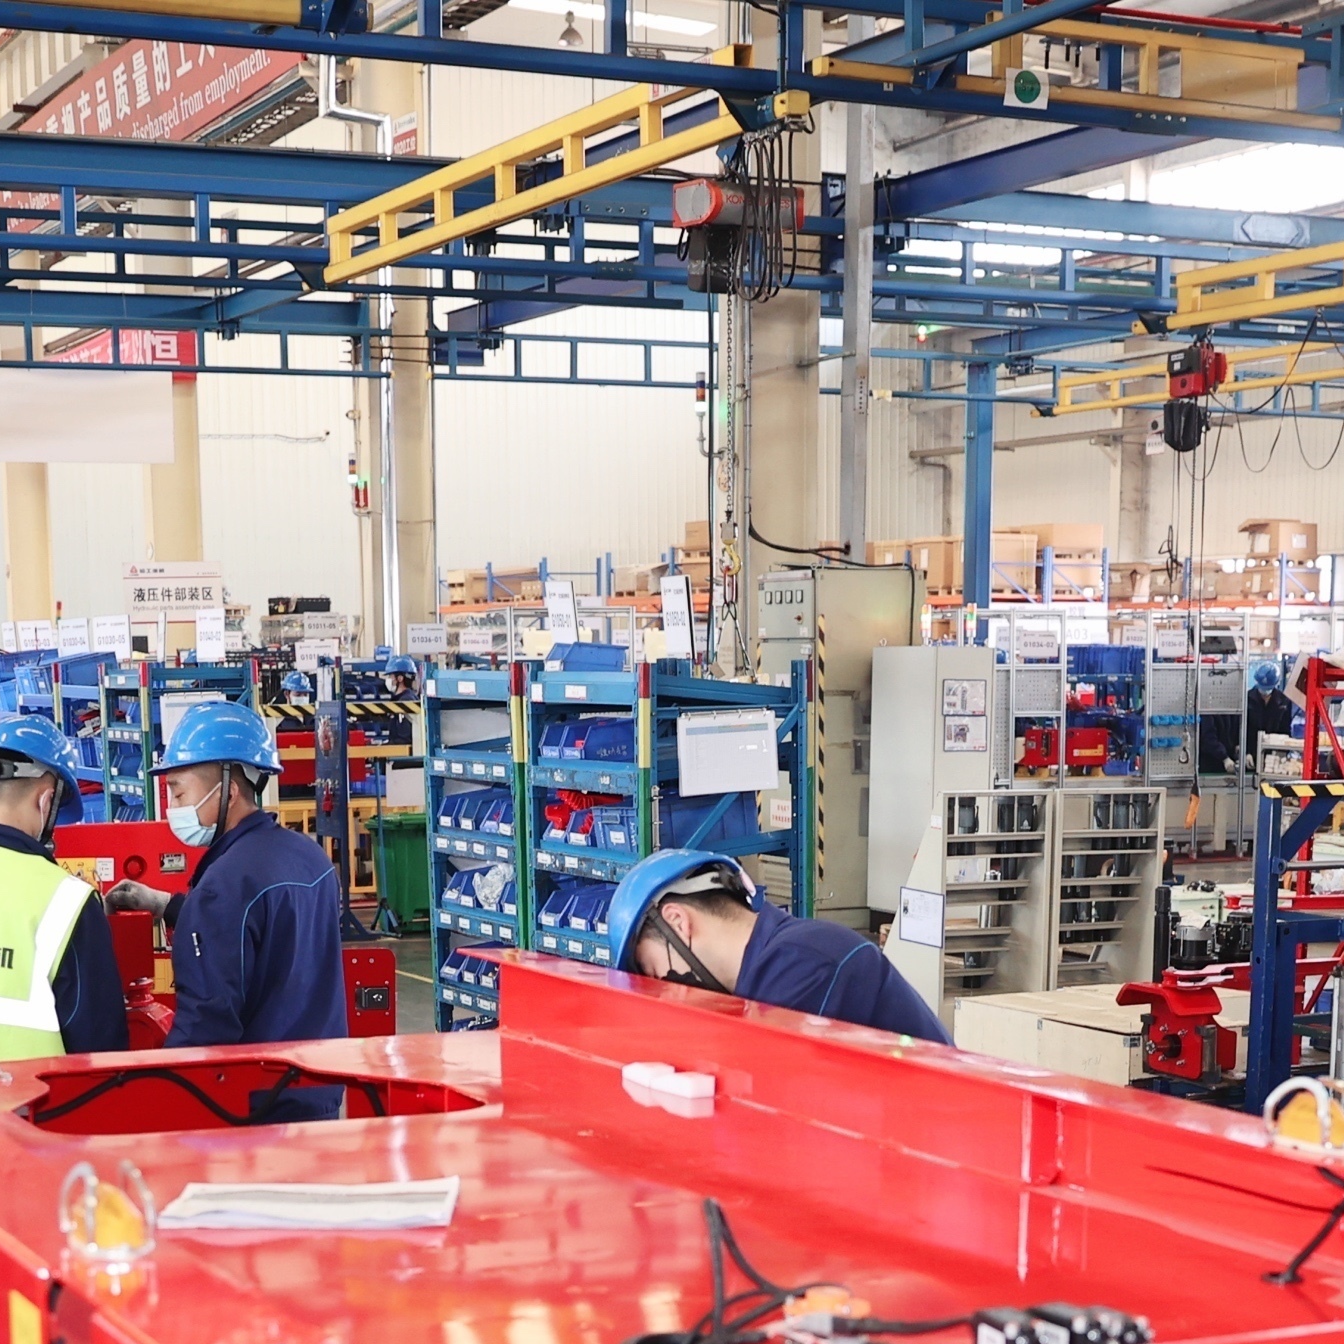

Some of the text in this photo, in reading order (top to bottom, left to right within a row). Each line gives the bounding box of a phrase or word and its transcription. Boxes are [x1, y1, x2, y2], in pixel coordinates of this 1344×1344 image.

[179, 91, 205, 123] from
[205, 50, 272, 105] employment.
[133, 587, 214, 602] 液压件部装区
[97, 634, 126, 646] G1030-05
